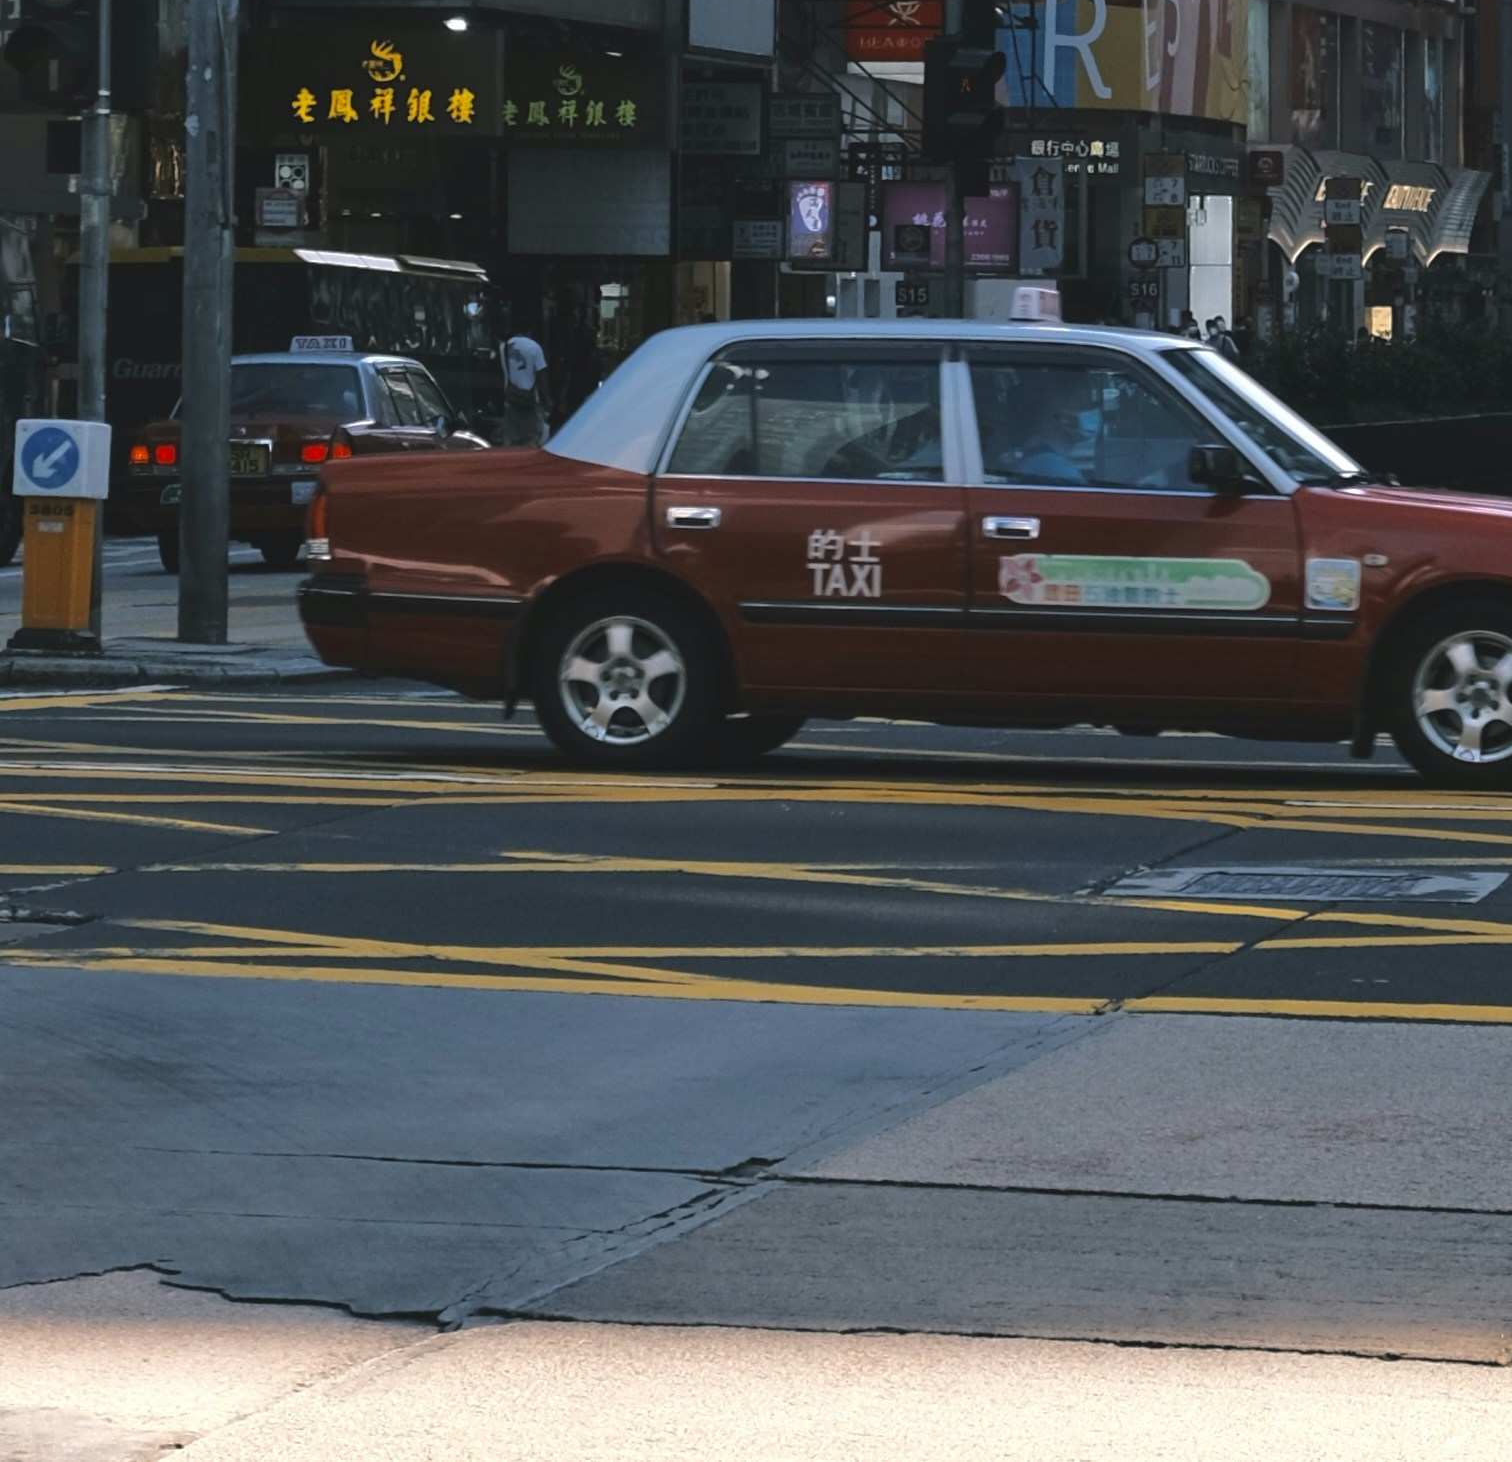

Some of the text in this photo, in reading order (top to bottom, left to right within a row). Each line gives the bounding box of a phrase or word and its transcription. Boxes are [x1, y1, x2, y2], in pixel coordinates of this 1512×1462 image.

[292, 86, 477, 125] 老鳳祥銀樓
[1031, 140, 1120, 158] 銀行中心廣場
[896, 287, 927, 304] S15
[1130, 283, 1157, 297] S16
[295, 337, 347, 349] TAXI
[807, 528, 881, 563] 的士
[807, 562, 881, 598] TAXI
